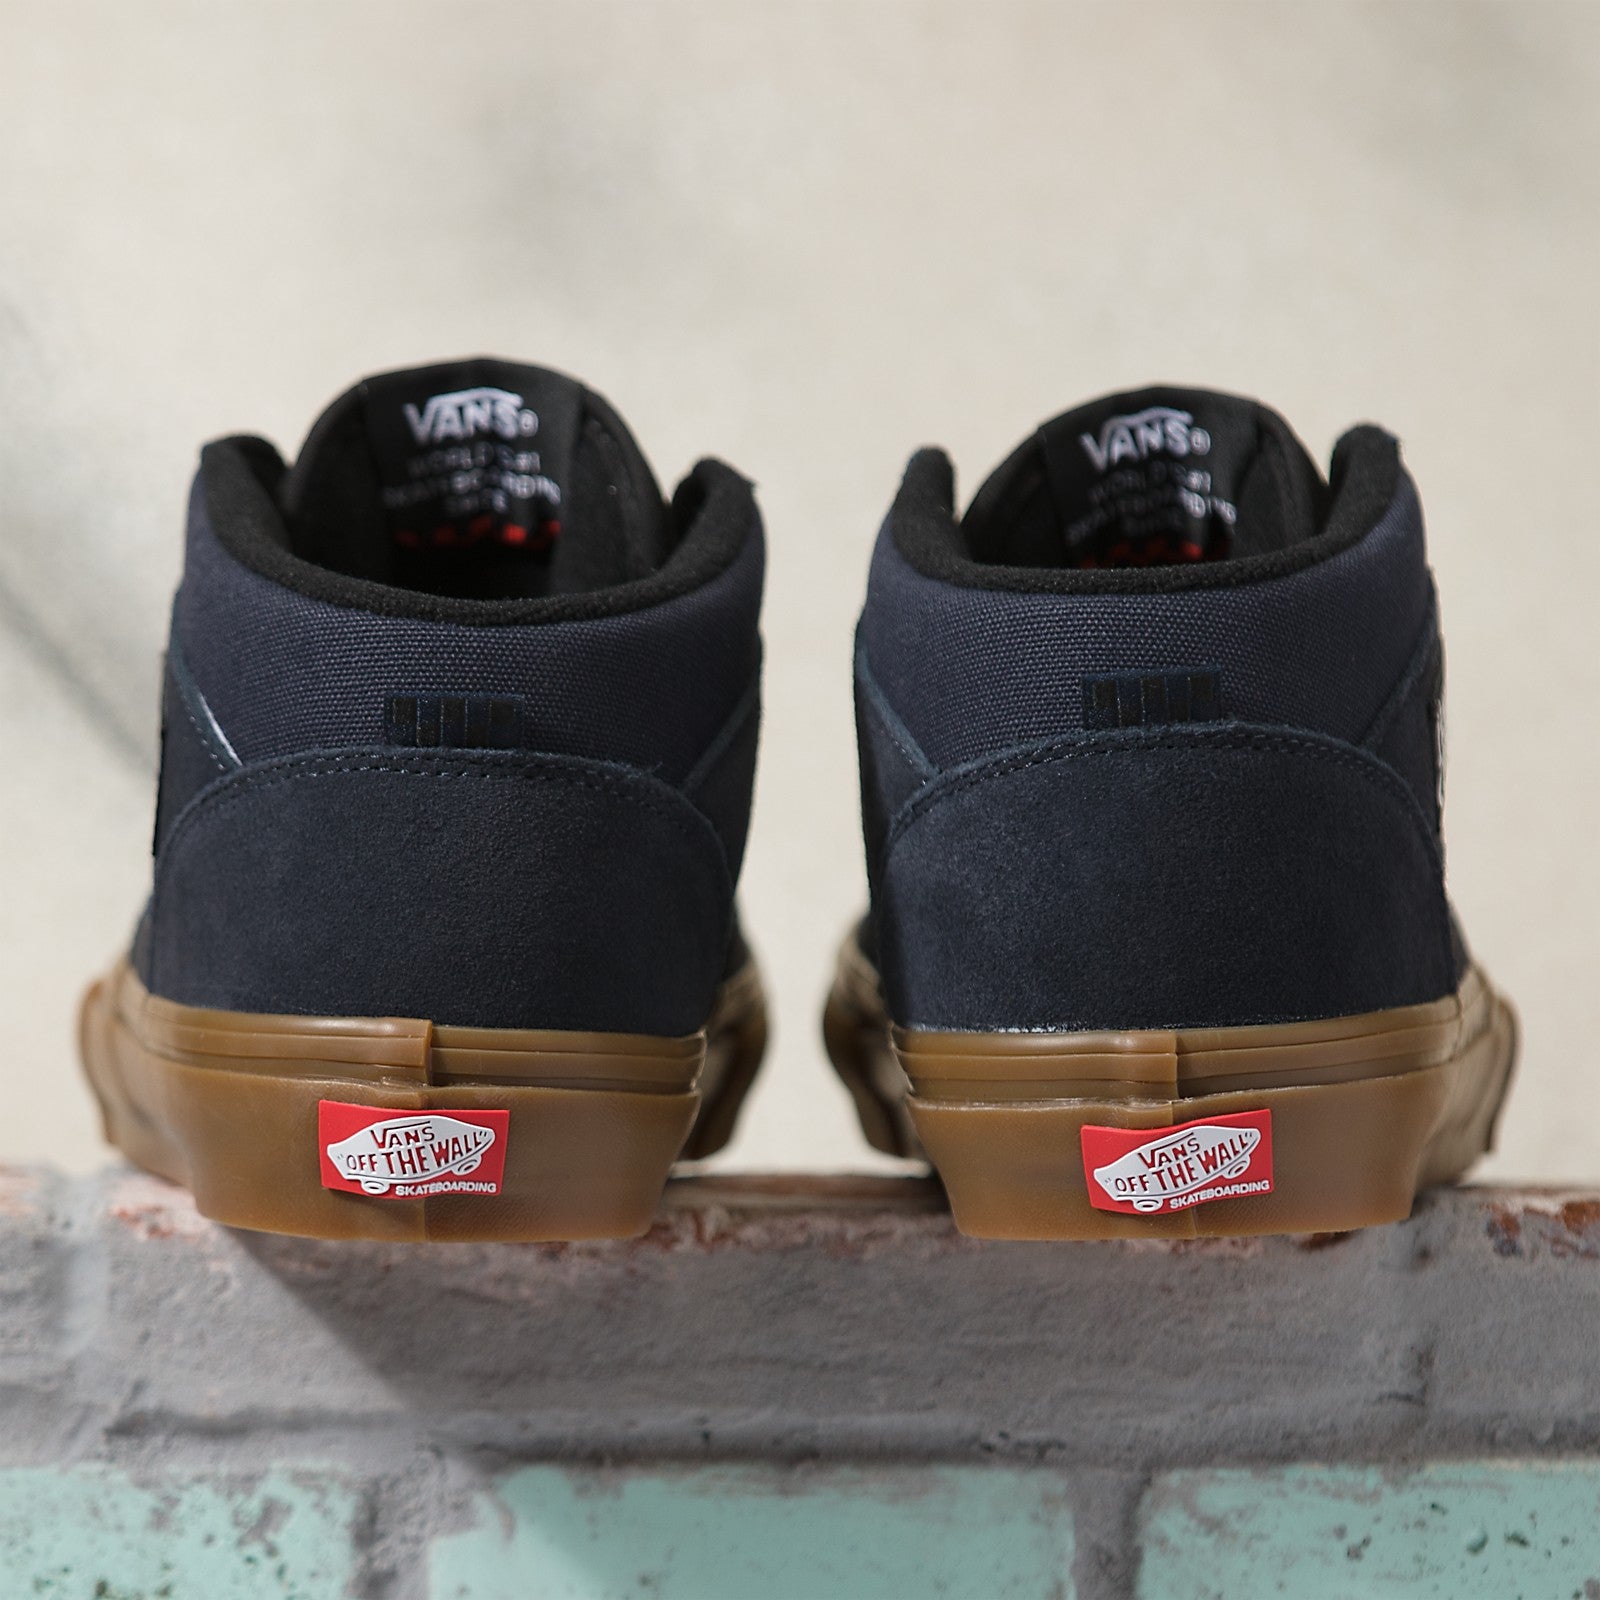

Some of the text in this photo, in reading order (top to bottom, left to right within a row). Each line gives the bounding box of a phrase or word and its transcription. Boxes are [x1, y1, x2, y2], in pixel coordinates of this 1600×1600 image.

[370, 1121, 435, 1149] VANS
[381, 1145, 431, 1175] THE
[1137, 1132, 1200, 1170] VANS
[395, 1181, 497, 1197] SKATEBOARDING
[1152, 1161, 1199, 1191] THE
[1169, 1179, 1270, 1209] SKATEBOARDING
